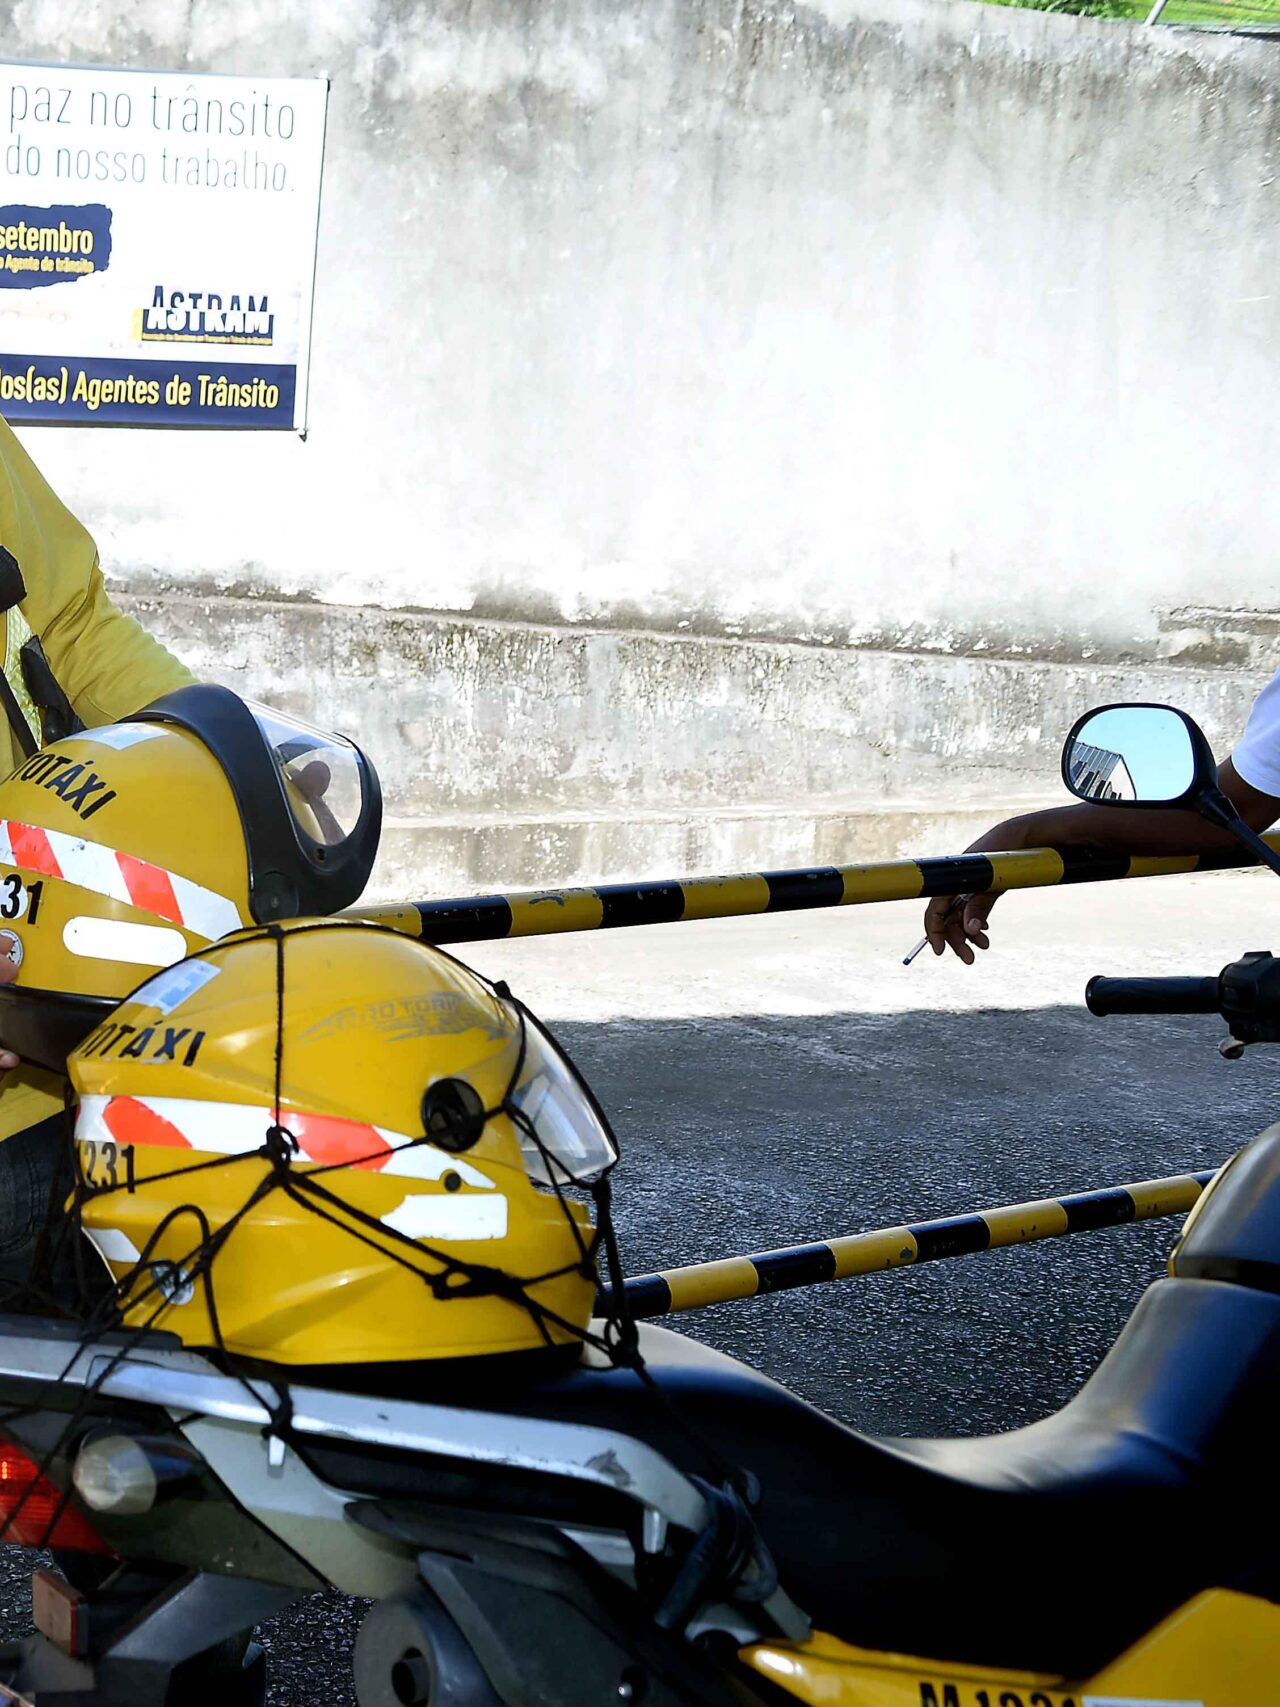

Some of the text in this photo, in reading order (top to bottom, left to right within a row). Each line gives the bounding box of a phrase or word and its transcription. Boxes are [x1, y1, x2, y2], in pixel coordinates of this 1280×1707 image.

[10, 85, 71, 133] paz
[91, 91, 131, 128] no
[150, 84, 294, 139] trânsito
[6, 134, 40, 176] do
[56, 148, 146, 183] nosso
[161, 147, 295, 192] trabalho.
[146, 284, 270, 335] ASTRAM
[73, 371, 159, 411] Agentes
[165, 374, 191, 406] de
[197, 375, 279, 409] Trânsito
